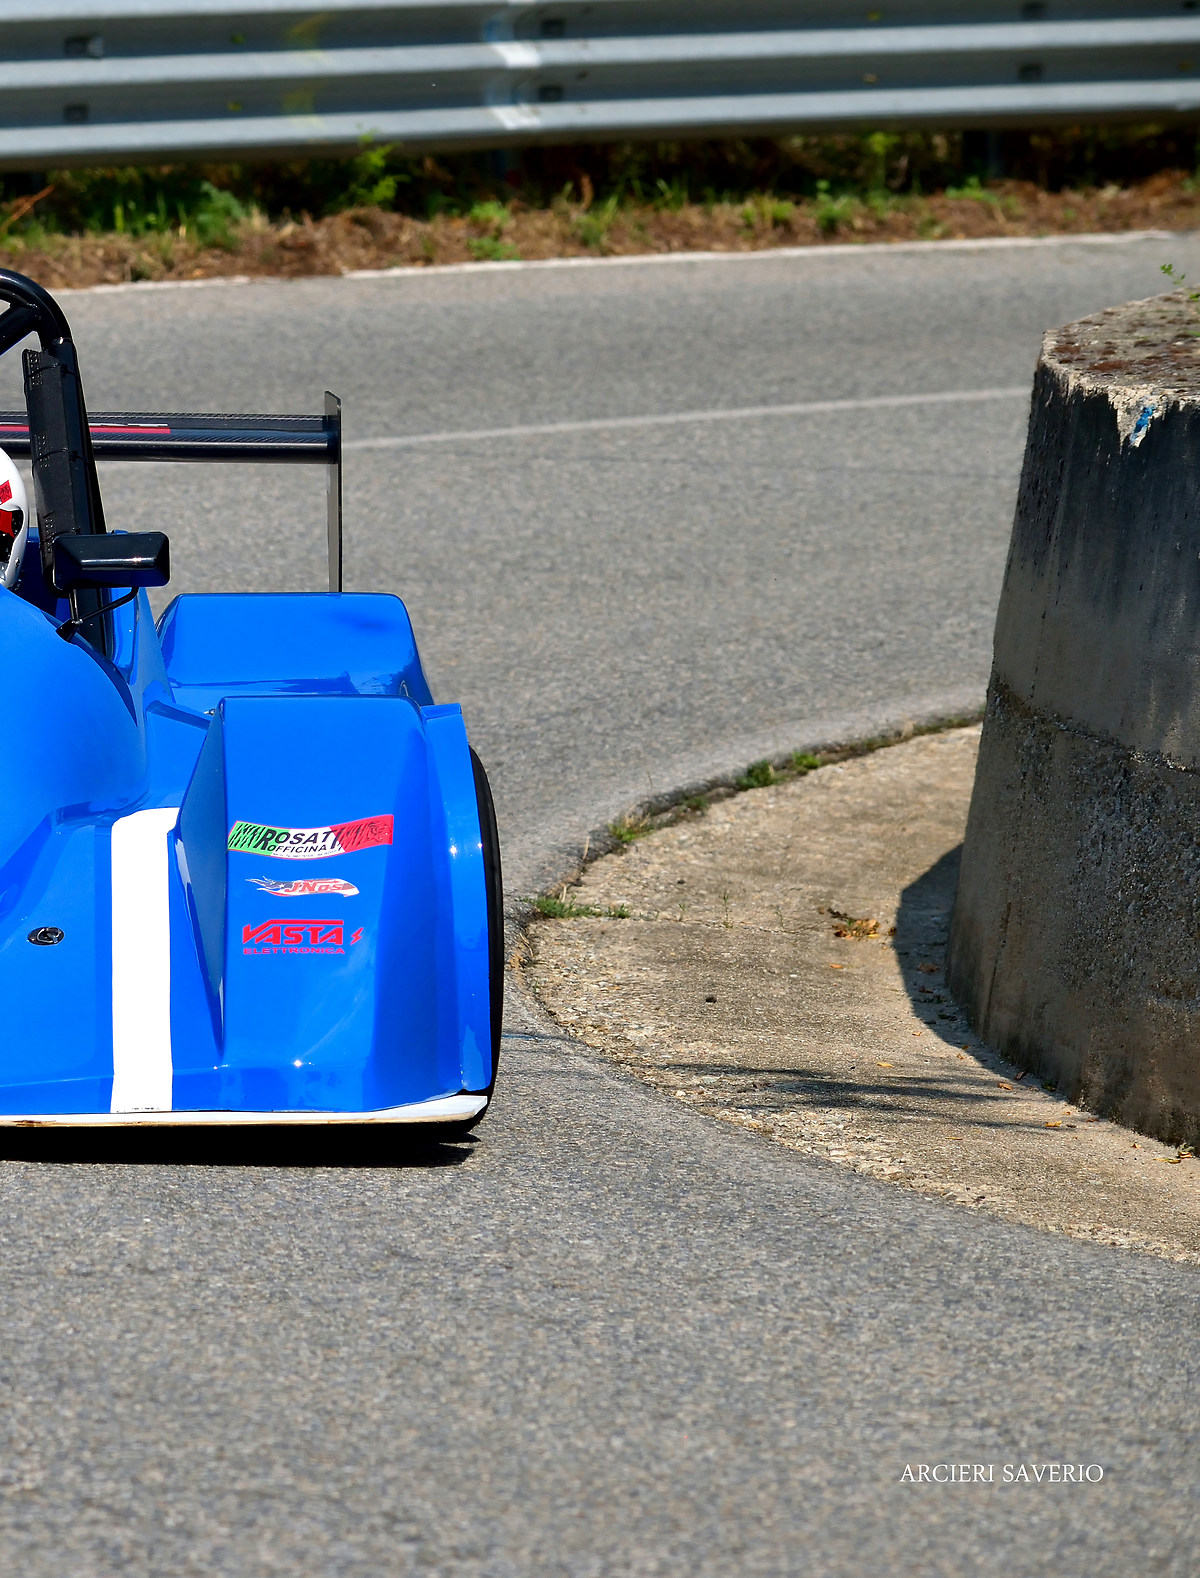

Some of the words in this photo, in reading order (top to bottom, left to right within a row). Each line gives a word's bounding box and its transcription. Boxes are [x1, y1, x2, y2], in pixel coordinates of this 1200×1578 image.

[255, 828, 344, 850] ROSATI
[267, 844, 327, 854] OFFICINA
[242, 919, 344, 946] VASTA
[243, 947, 346, 955] ELETTRONICA
